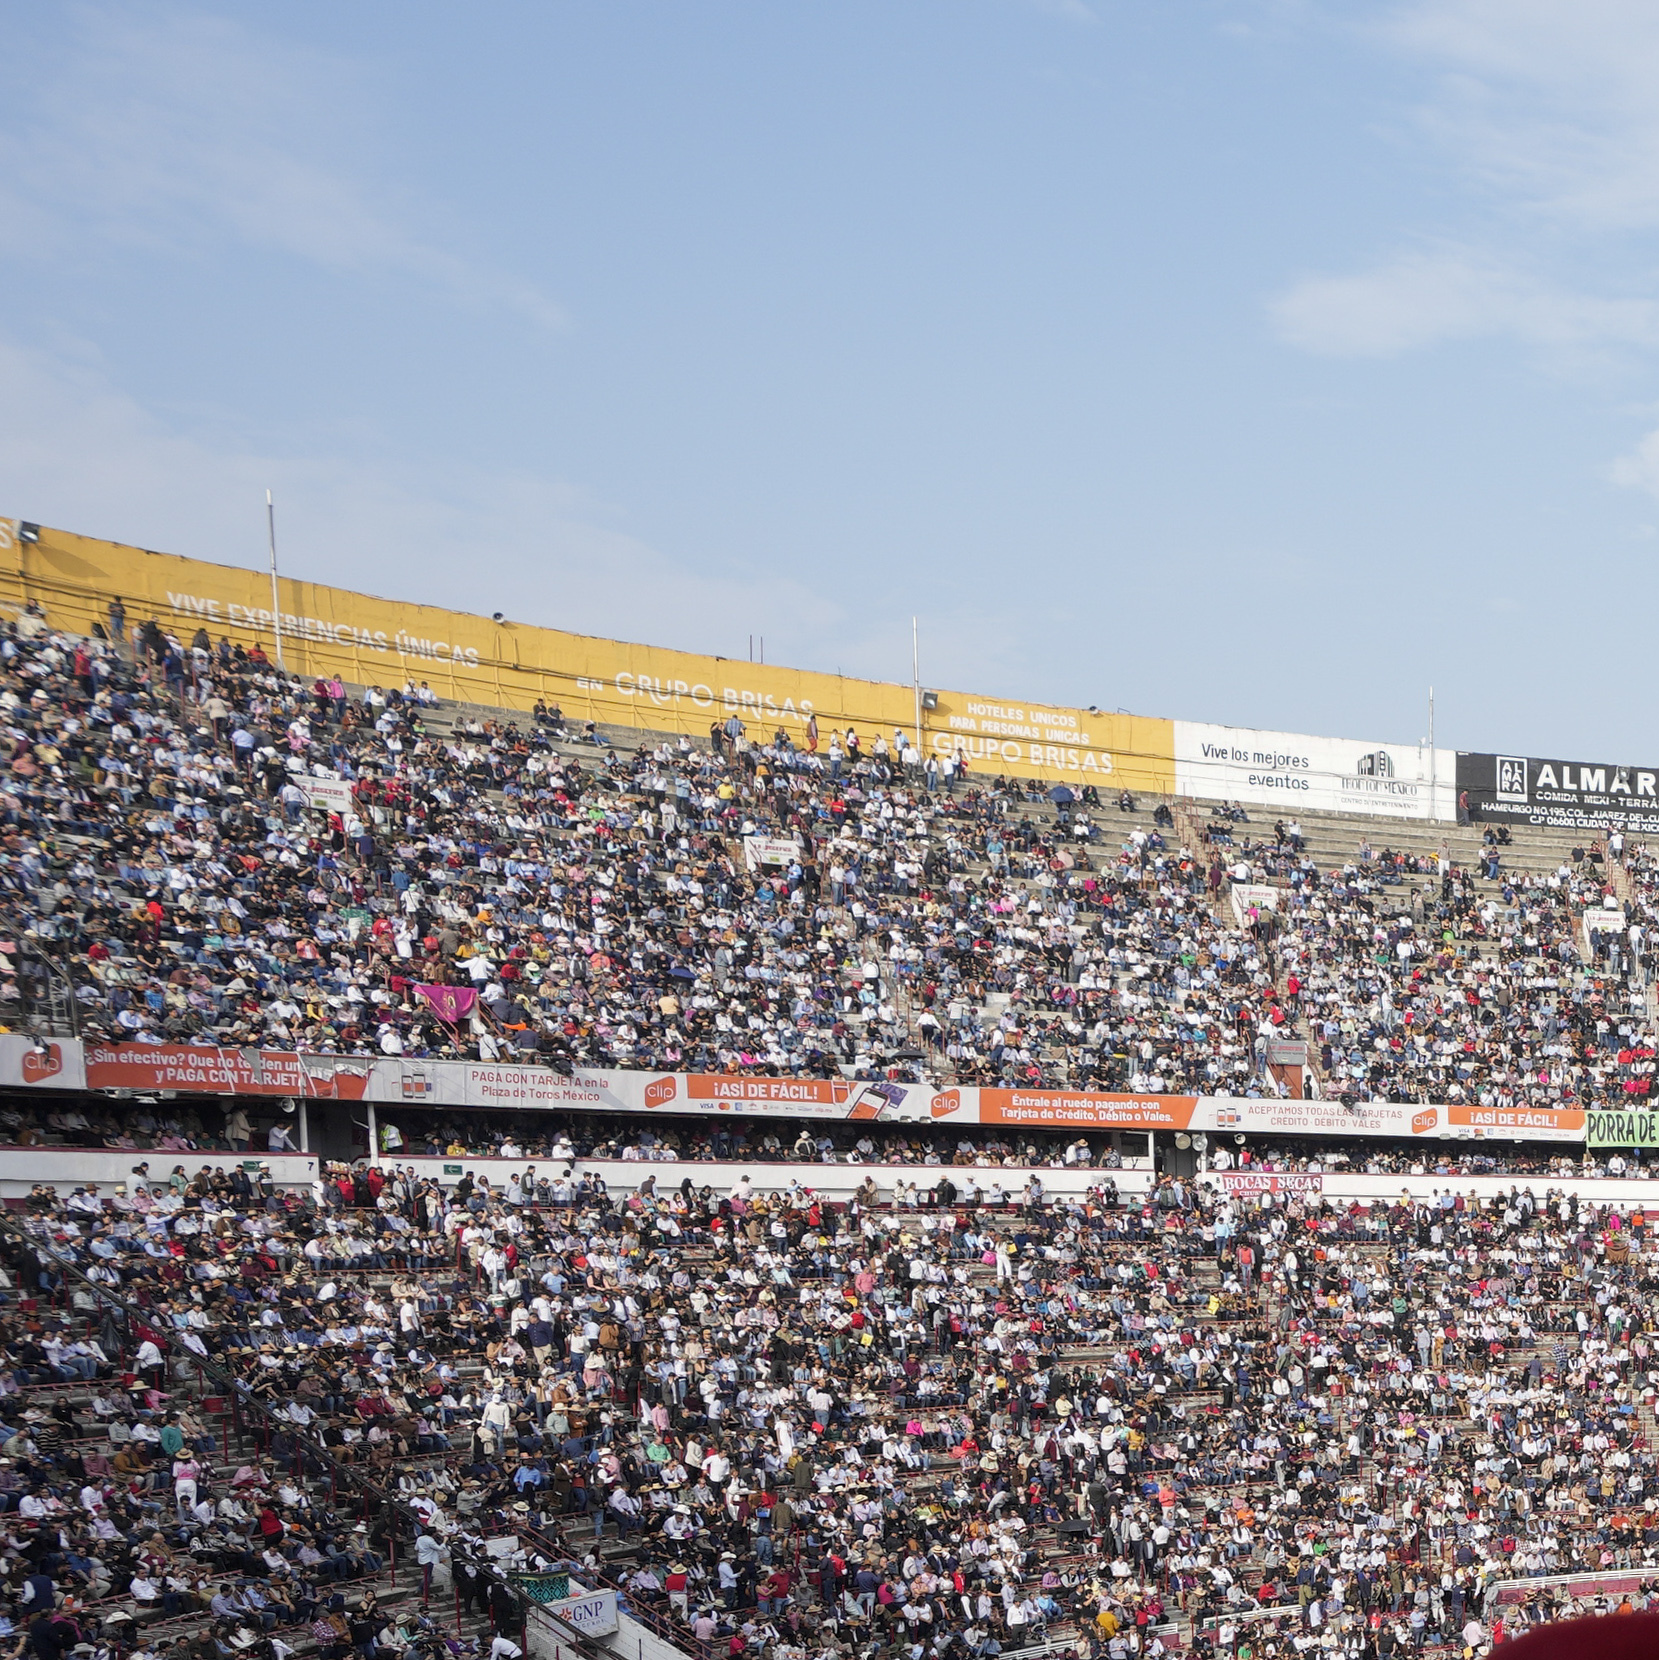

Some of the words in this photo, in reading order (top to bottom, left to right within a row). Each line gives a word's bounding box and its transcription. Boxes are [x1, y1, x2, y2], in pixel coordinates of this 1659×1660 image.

[166, 590, 221, 625] VIVE
[227, 603, 388, 653] EXPERIENCIAS
[395, 628, 480, 670] ÚNICAS
[577, 676, 603, 690] EN
[615, 671, 714, 708] GRUPO
[724, 687, 814, 722] BRISAS
[967, 702, 1024, 721] HOTELES
[1029, 709, 1076, 728] UNICOS
[949, 715, 976, 731] PARA
[981, 719, 1039, 740] PERSONAS
[1045, 729, 1090, 746] UNICAS
[932, 731, 1023, 763] GRUPO
[1029, 743, 1114, 775] BRISAS
[1201, 743, 1228, 760] Vive
[1231, 746, 1249, 762] los
[1253, 751, 1310, 769] mejores
[1248, 773, 1310, 791] eventos
[1536, 791, 1578, 804] COMIDA
[1481, 801, 1533, 815] HAMBURGO
[86, 1049, 116, 1066] ¿Sin
[119, 1051, 185, 1067] efectivo?
[188, 1053, 214, 1069] Que
[167, 1067, 206, 1083] PAGA
[210, 1069, 239, 1084] CON
[472, 1071, 503, 1083] PAGA
[506, 1072, 527, 1084] CON
[531, 1073, 581, 1087] TARJETA
[481, 1085, 511, 1097] Plaza
[529, 1088, 560, 1099] Toros
[563, 1088, 600, 1101] México
[647, 1084, 674, 1099] clip
[714, 1080, 745, 1098] ¡ASÍ
[751, 1082, 768, 1098] DE
[770, 1079, 817, 1100] FÁCIL!
[1012, 1093, 1050, 1107] Éntrale
[1063, 1097, 1094, 1108] ruedo
[1095, 1099, 1139, 1111] pagando
[1141, 1101, 1160, 1110] con
[1001, 1107, 1037, 1120] Tarjeta
[1055, 1107, 1097, 1122] Crédito,
[1099, 1109, 1132, 1121] Débito
[1143, 1110, 1174, 1122] Vales.
[1248, 1105, 1303, 1116] ACEPTAMOS
[1305, 1107, 1335, 1117] TODAS
[1356, 1109, 1403, 1119] TARJETAS
[1352, 1119, 1381, 1129] VALES
[1587, 1112, 1635, 1143] PORRA
[1639, 1114, 1656, 1143] DE
[307, 1161, 314, 1171] 7
[1225, 1177, 1271, 1190] BOCAS
[1278, 1177, 1322, 1191] SECAS
[573, 1601, 603, 1622] GNP
